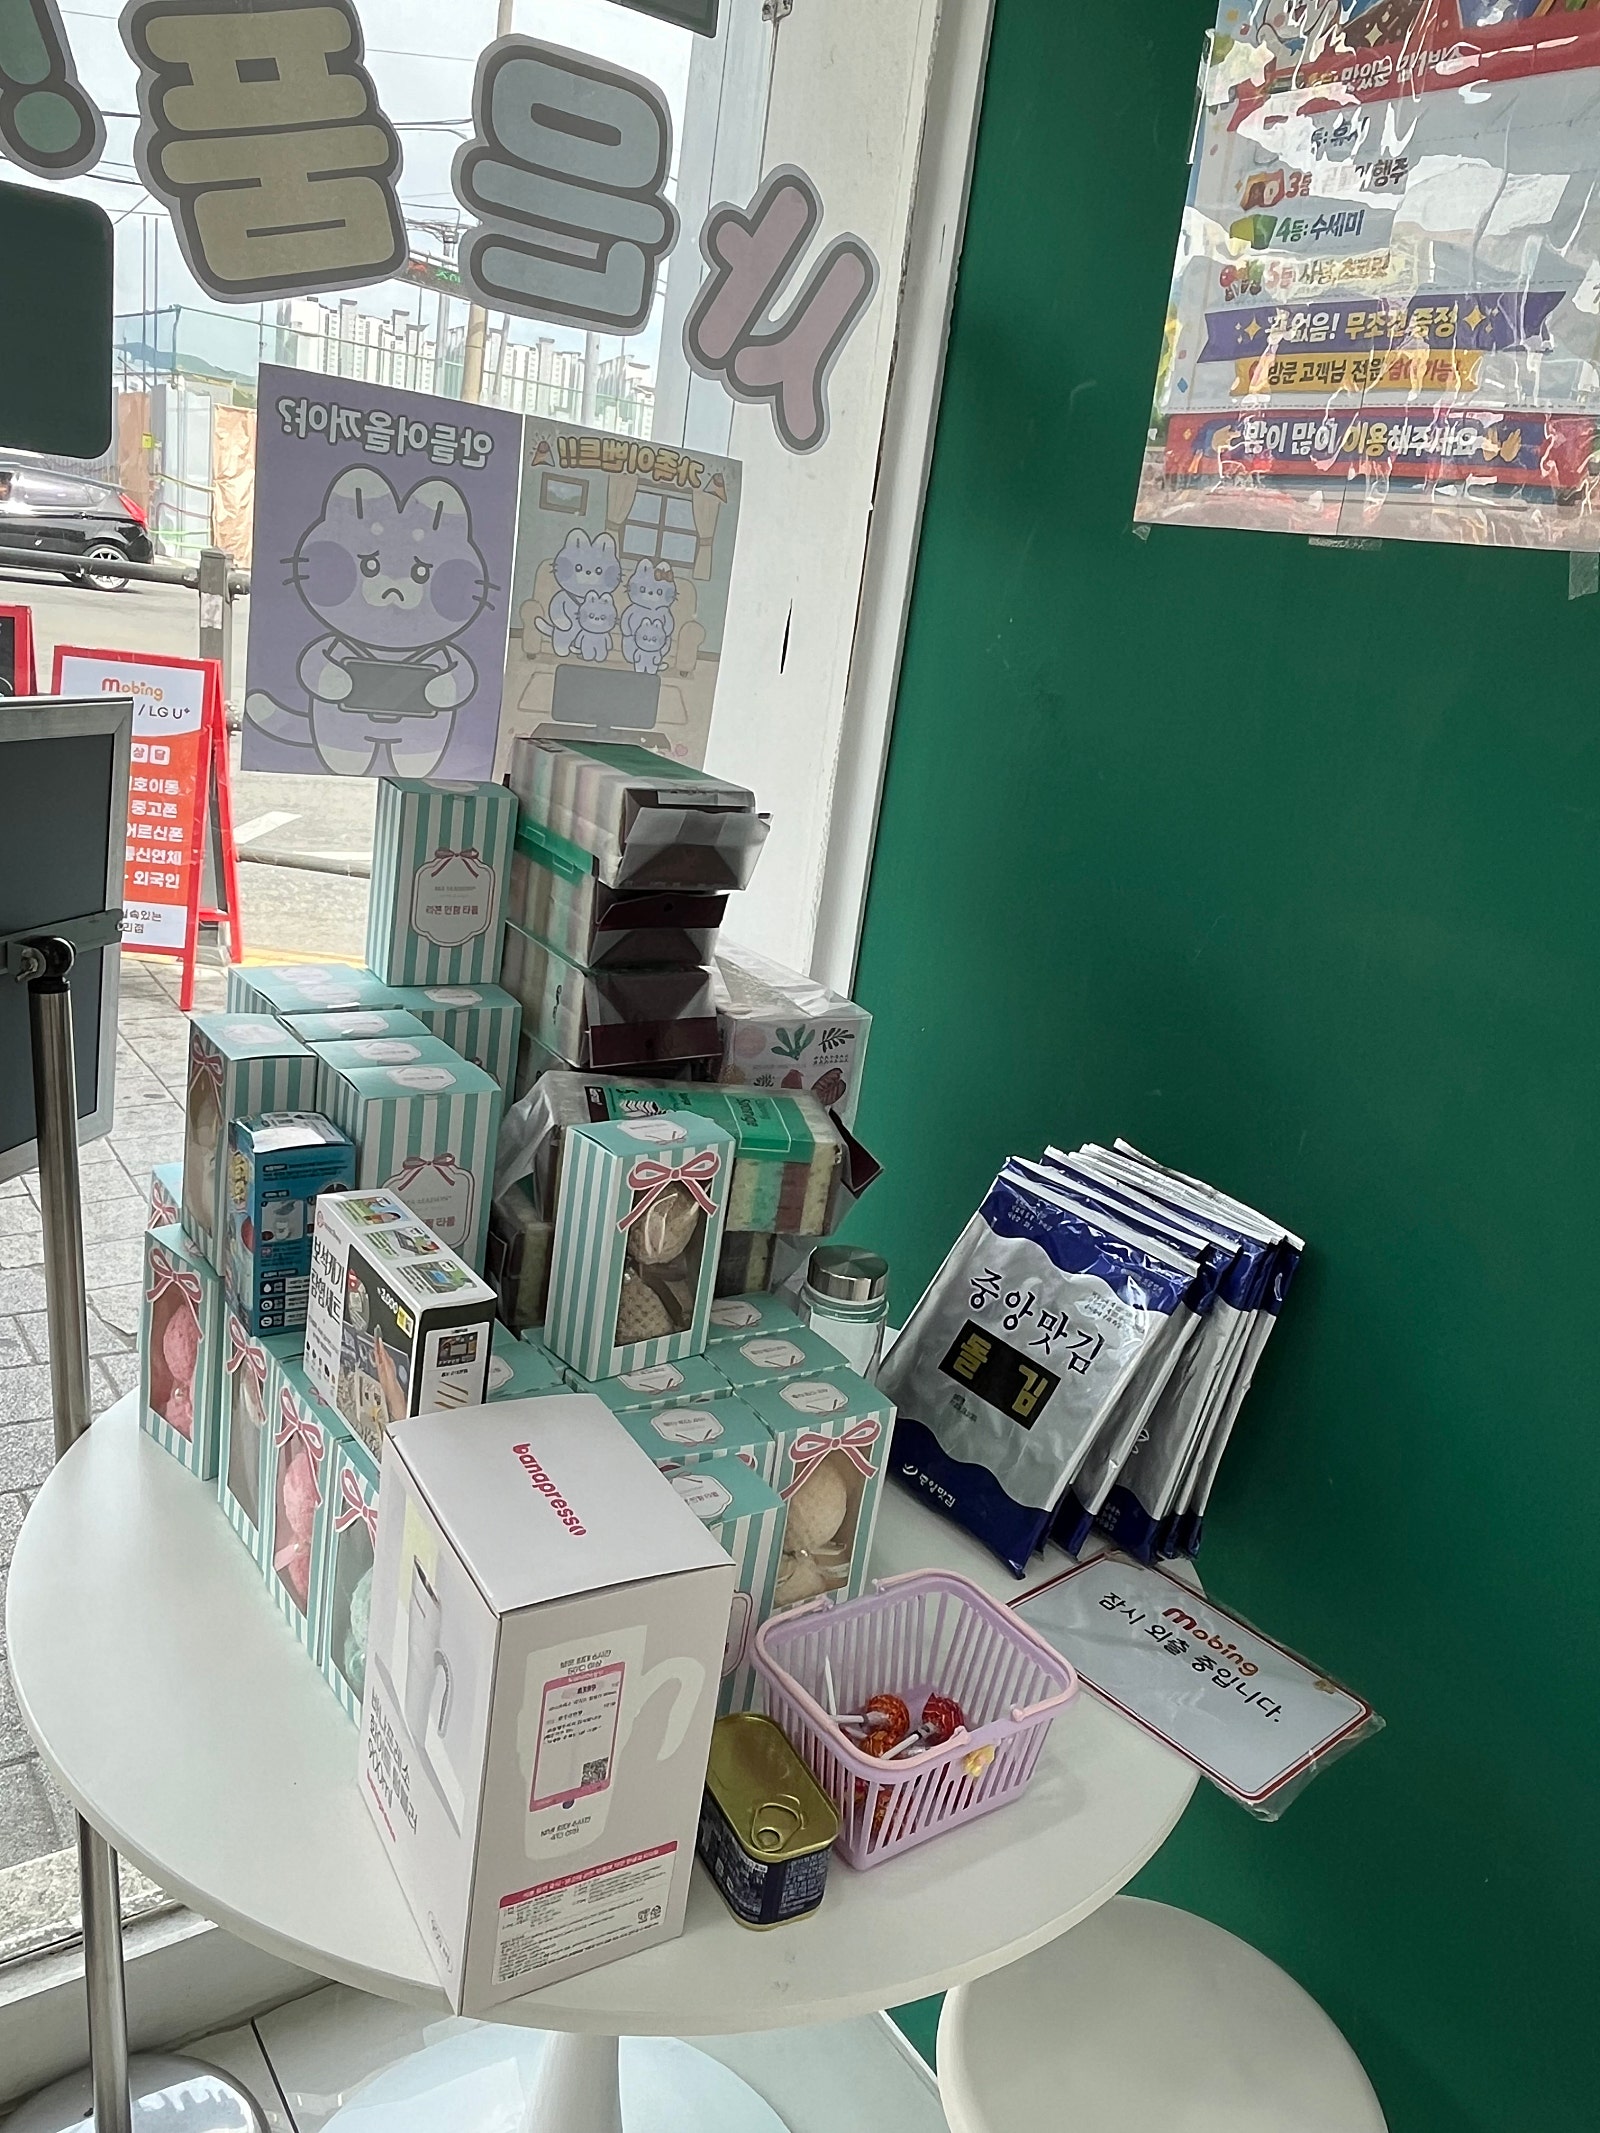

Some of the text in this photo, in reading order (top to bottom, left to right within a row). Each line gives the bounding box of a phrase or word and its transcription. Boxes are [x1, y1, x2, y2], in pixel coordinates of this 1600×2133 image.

[1276, 210, 1365, 242] 4등: 수세미
[1299, 359, 1347, 384] 고객님
[1244, 421, 1287, 454] 많이
[1292, 421, 1338, 455] 많이
[149, 705, 169, 718] LG
[130, 776, 179, 795] 호이동
[131, 800, 177, 818] 중고폰
[127, 823, 183, 842] 어르신폰
[133, 871, 180, 889] 외국인
[122, 923, 144, 933] 리점
[968, 1266, 1108, 1376] 중앙맛김
[512, 1441, 587, 1537] banapresso
[1098, 1590, 1286, 1723] 잠시 외출 중입니다.
